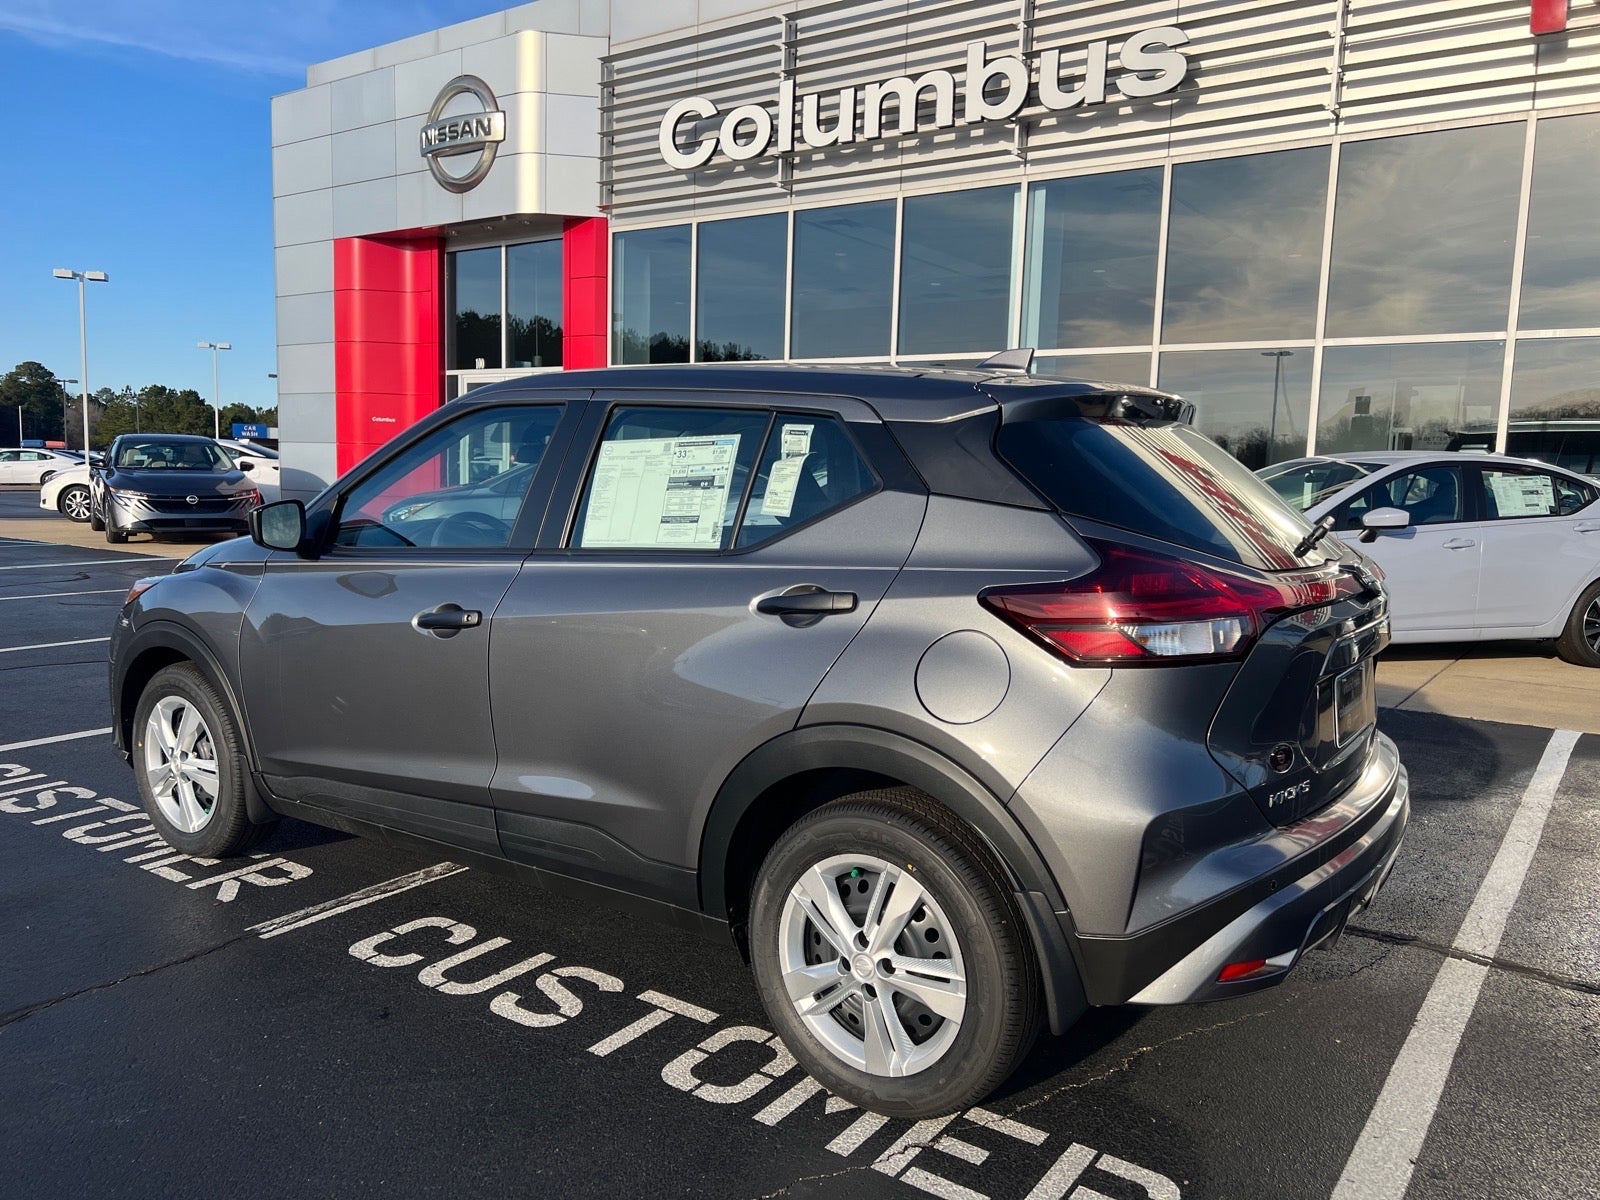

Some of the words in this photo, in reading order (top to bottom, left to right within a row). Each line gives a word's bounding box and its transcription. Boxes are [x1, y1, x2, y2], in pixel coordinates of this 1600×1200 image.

[659, 26, 1189, 170] Columbus
[421, 117, 492, 149] NISSAN
[677, 449, 687, 459] 33
